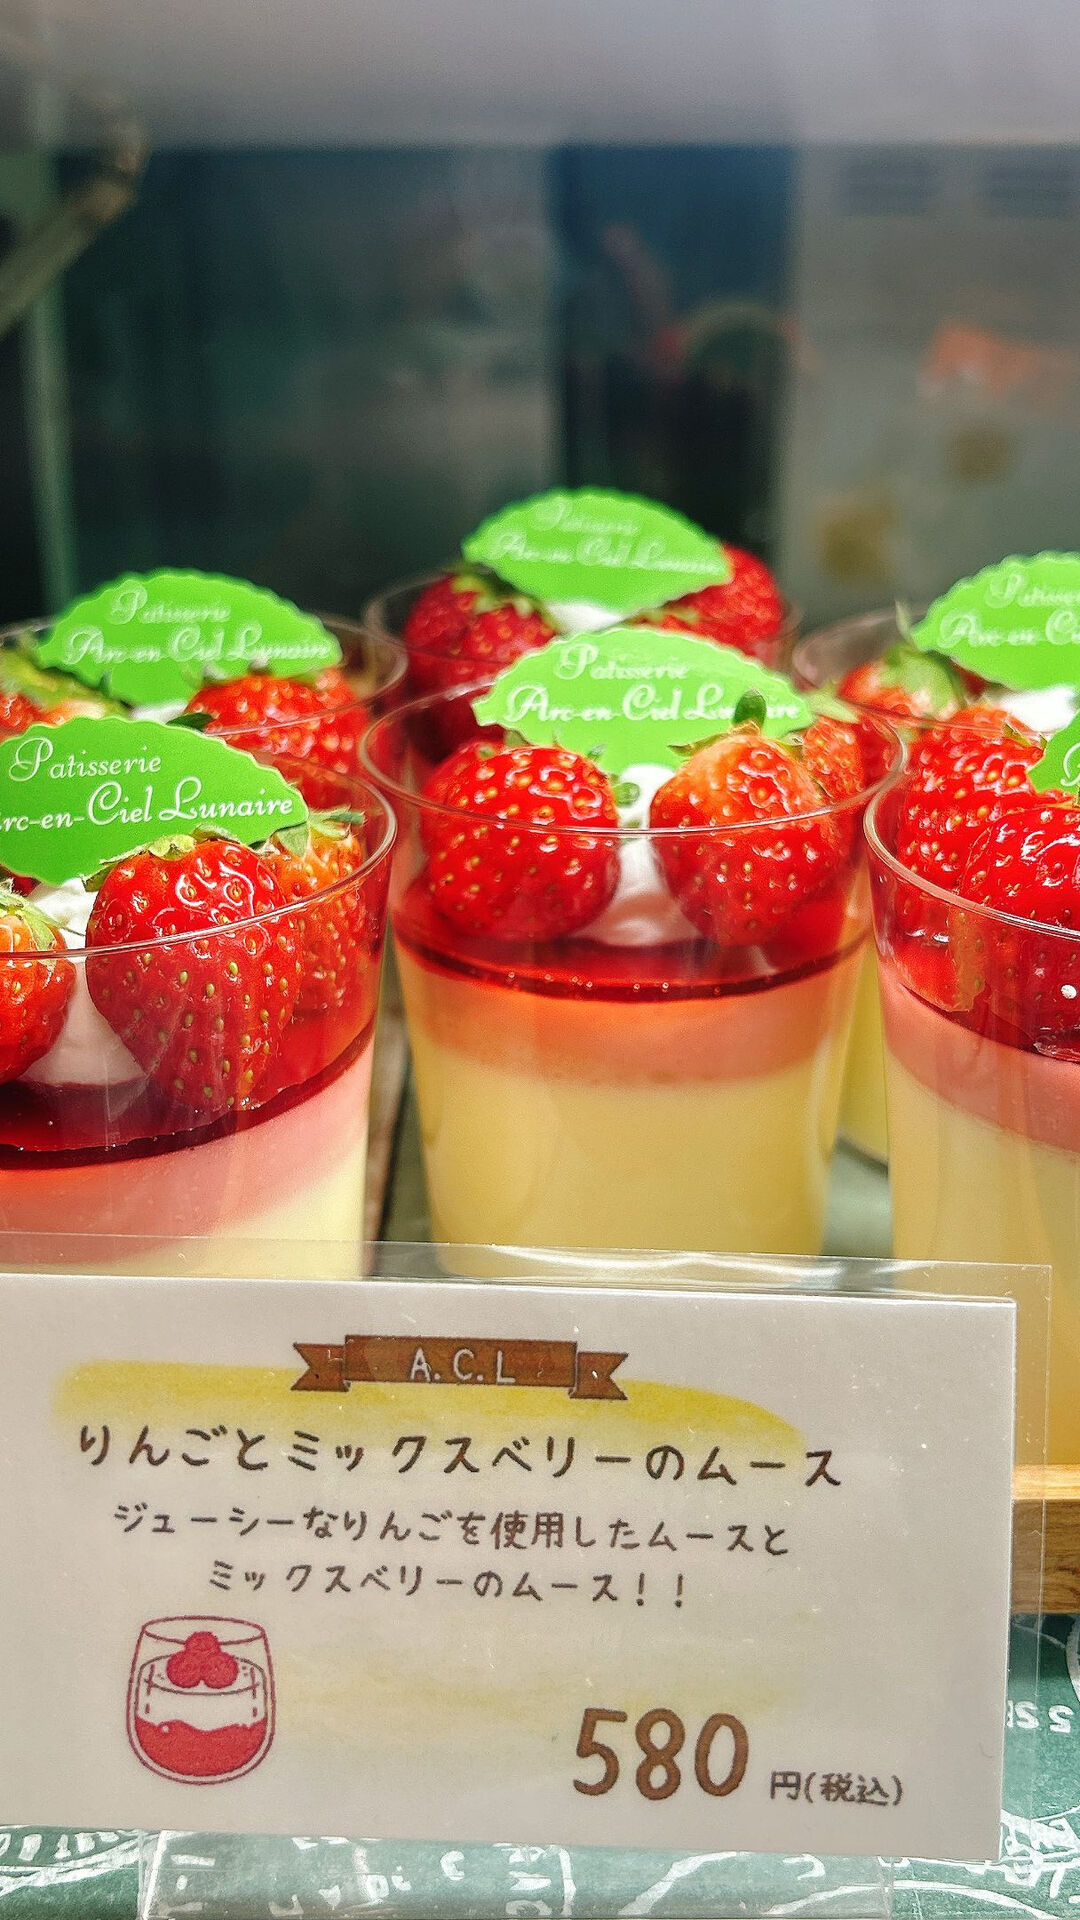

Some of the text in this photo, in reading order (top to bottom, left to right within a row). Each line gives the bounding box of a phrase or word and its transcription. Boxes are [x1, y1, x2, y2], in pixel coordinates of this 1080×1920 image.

[8, 736, 162, 782] Patisserie
[0, 776, 293, 832] rc-en-Ciel Lunaire
[409, 1346, 516, 1386] A.C.L
[79, 1424, 842, 1487] りんごとミックスベリーのムース
[114, 1502, 789, 1556] ジューシーなりんごを使用したムースと
[572, 1707, 749, 1800] 580
